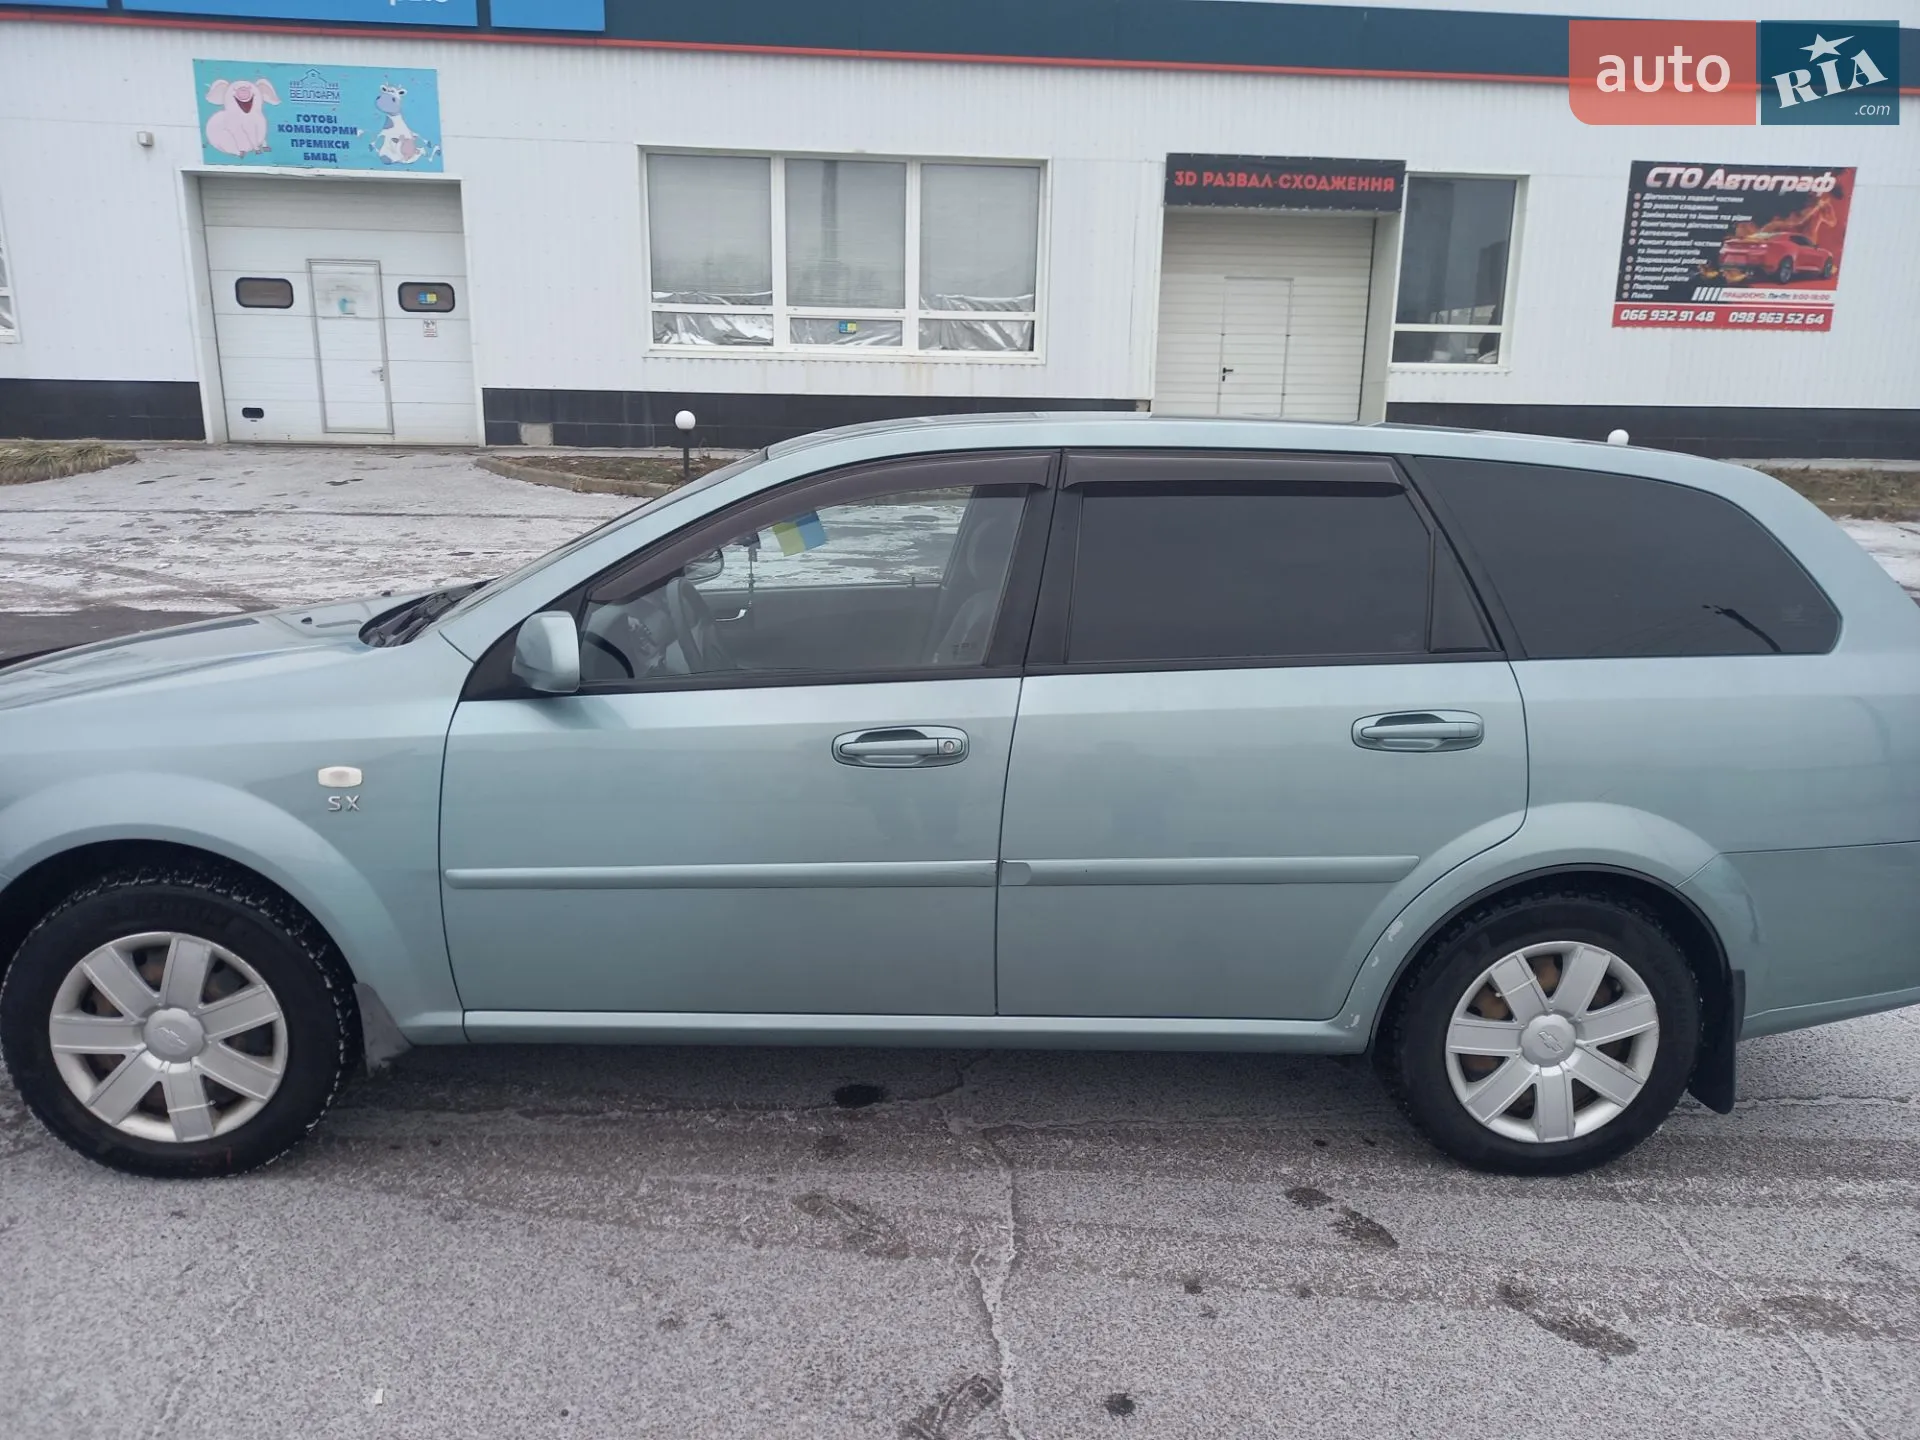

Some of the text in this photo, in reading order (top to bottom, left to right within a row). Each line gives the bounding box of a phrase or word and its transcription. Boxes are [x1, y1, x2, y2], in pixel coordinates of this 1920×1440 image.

[296, 114, 337, 124] ГОТОВІ
[277, 124, 358, 135] КОМБІКОРМИ
[290, 138, 350, 150] ПРЕМІКСИ
[303, 152, 338, 163] БМВД
[1174, 171, 1197, 186] 3D
[1645, 166, 1836, 196] СТО Автограф
[1620, 309, 1825, 325] 066 932 91 48 098 963 52 64
[327, 795, 360, 812] SX
